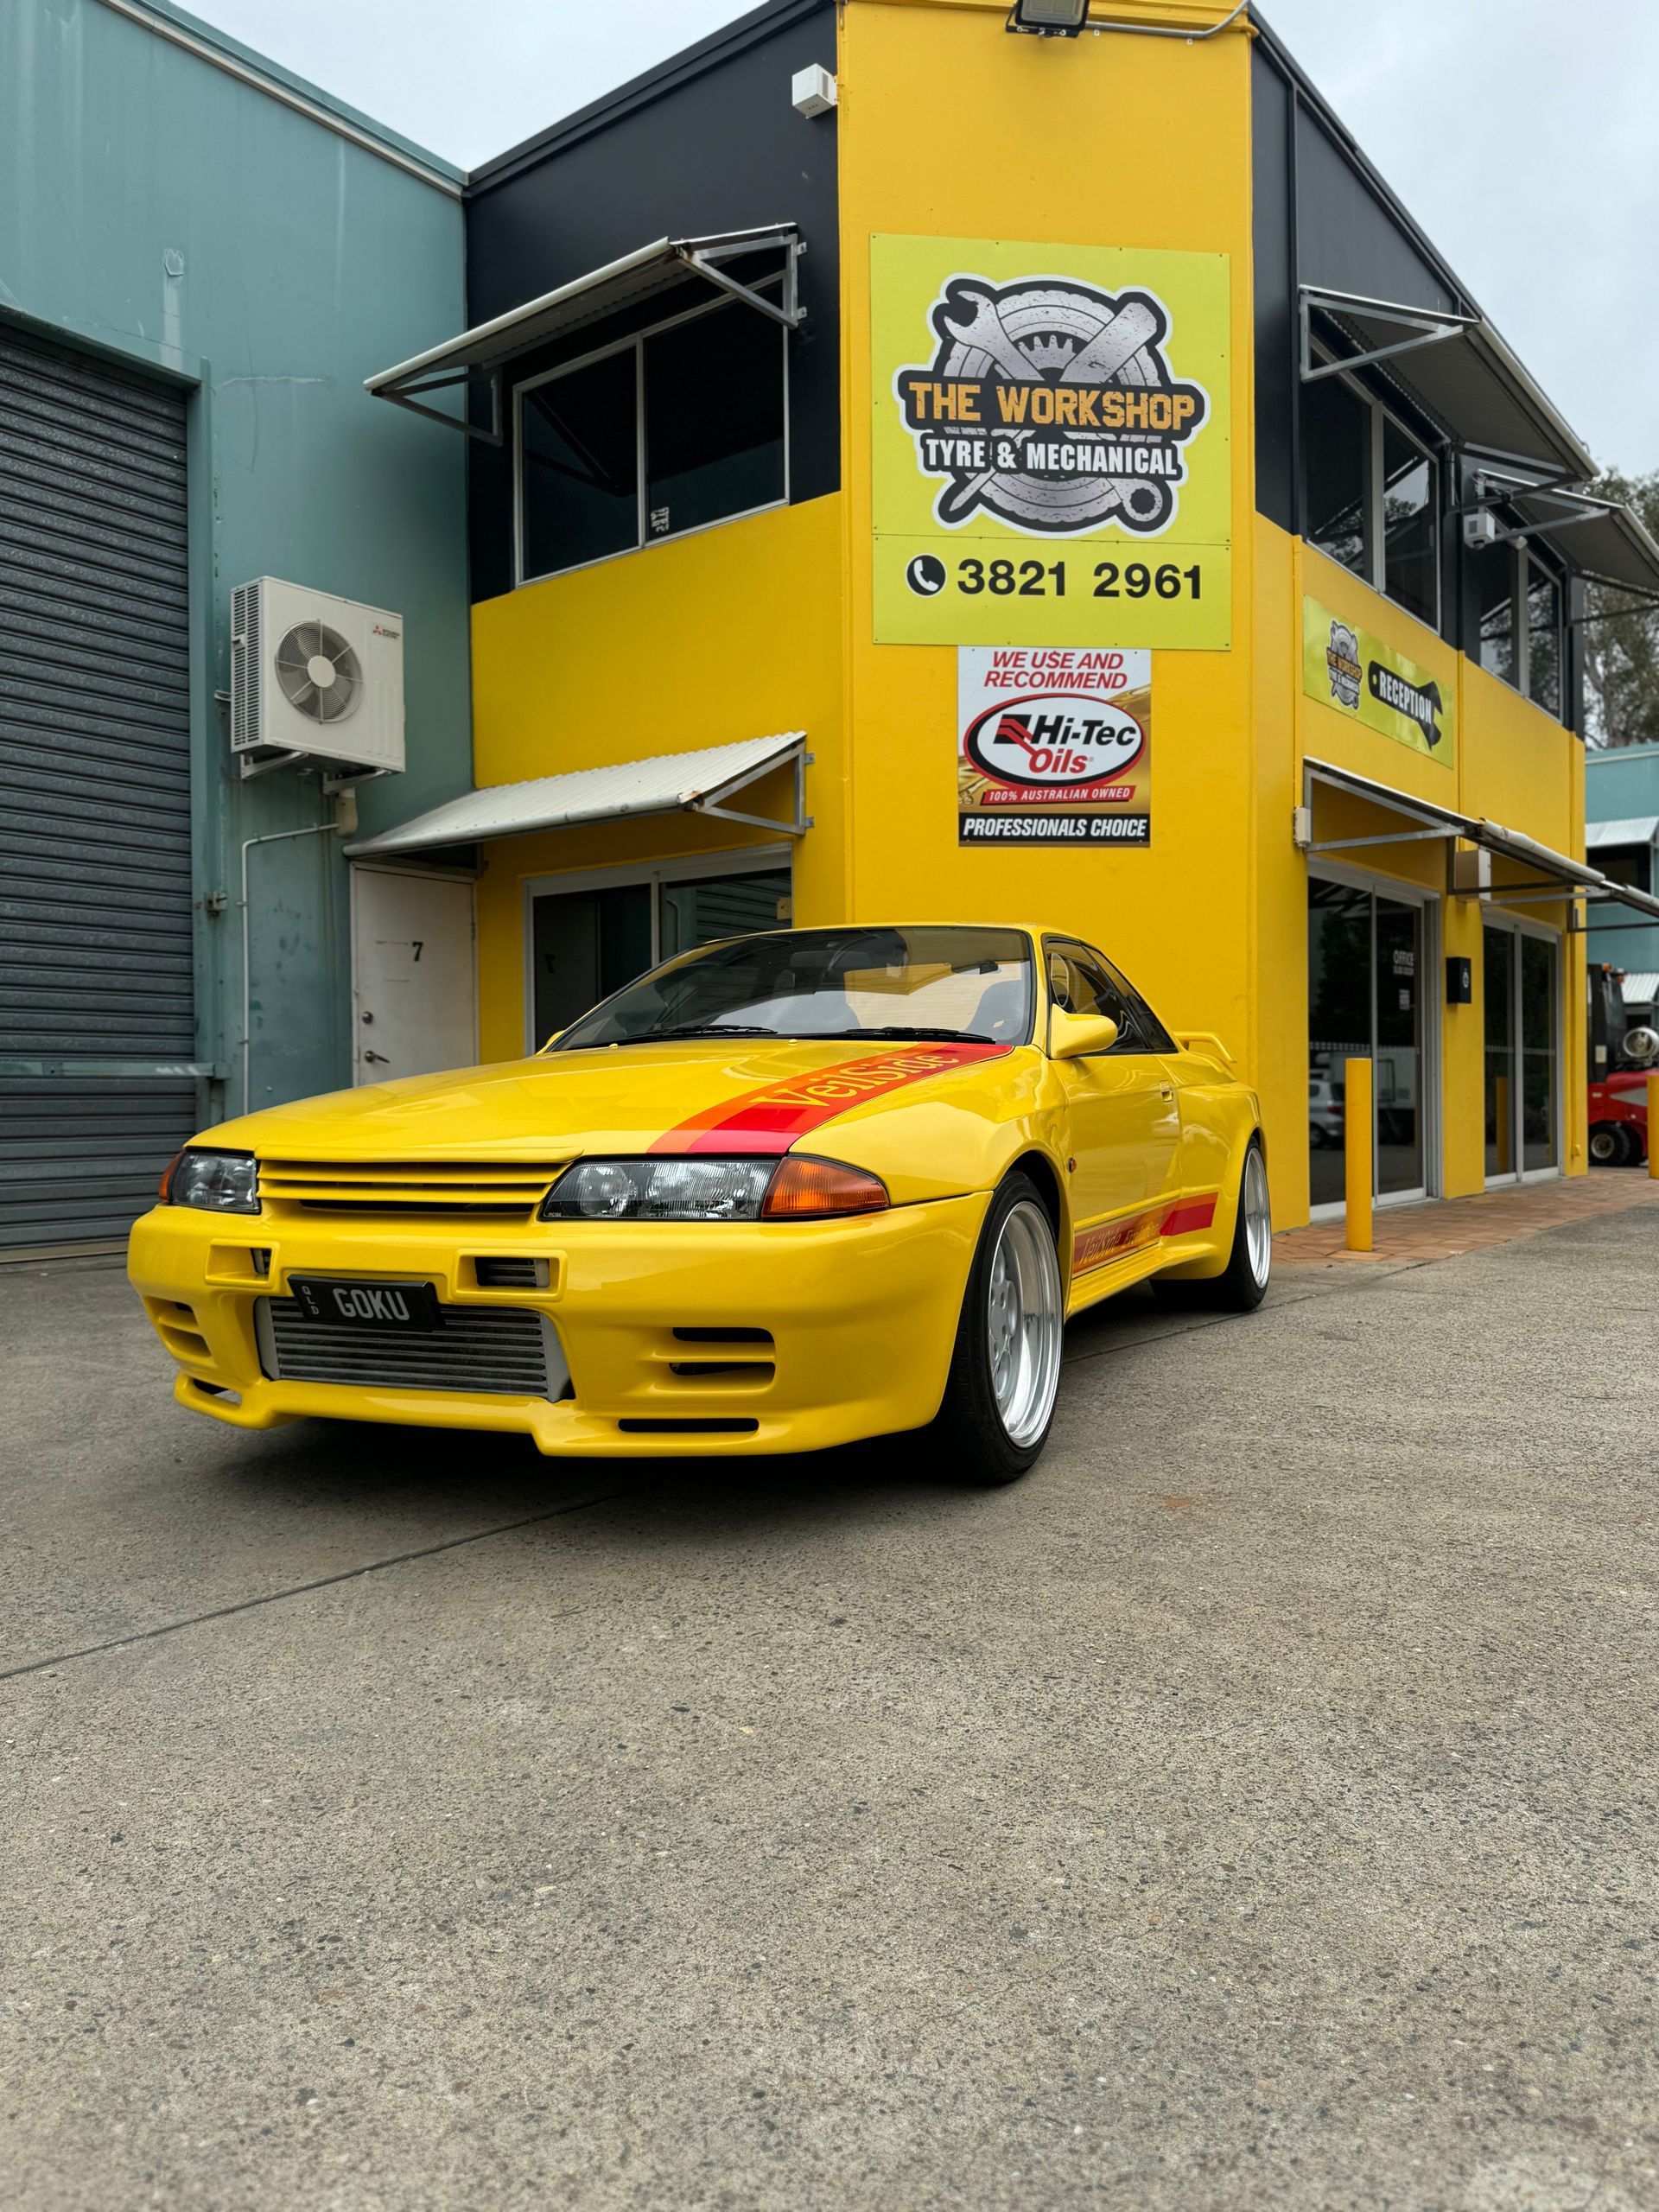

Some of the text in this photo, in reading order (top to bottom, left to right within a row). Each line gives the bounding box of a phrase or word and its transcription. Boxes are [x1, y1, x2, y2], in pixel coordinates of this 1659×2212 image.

[908, 381, 1195, 430] THE WORKSHOP
[925, 438, 1178, 475] TYRE & MECHANICAL
[957, 558, 1201, 600] 3821 2961
[993, 651, 1124, 670] WE USE AND
[983, 671, 1128, 690] RECOMMEND
[1379, 671, 1433, 725] RECEPTION
[1030, 715, 1137, 746] Hi-Tec
[1028, 747, 1088, 774] Oils
[988, 787, 1131, 802] 100% AUSTRALIAN OWNED
[963, 817, 1147, 837] PROFESSIONALS CHOICE
[411, 941, 424, 962] 7
[1393, 950, 1414, 967] OFFICE
[748, 1051, 961, 1108] VeilSide
[302, 1285, 410, 1321] QLD GOKU
